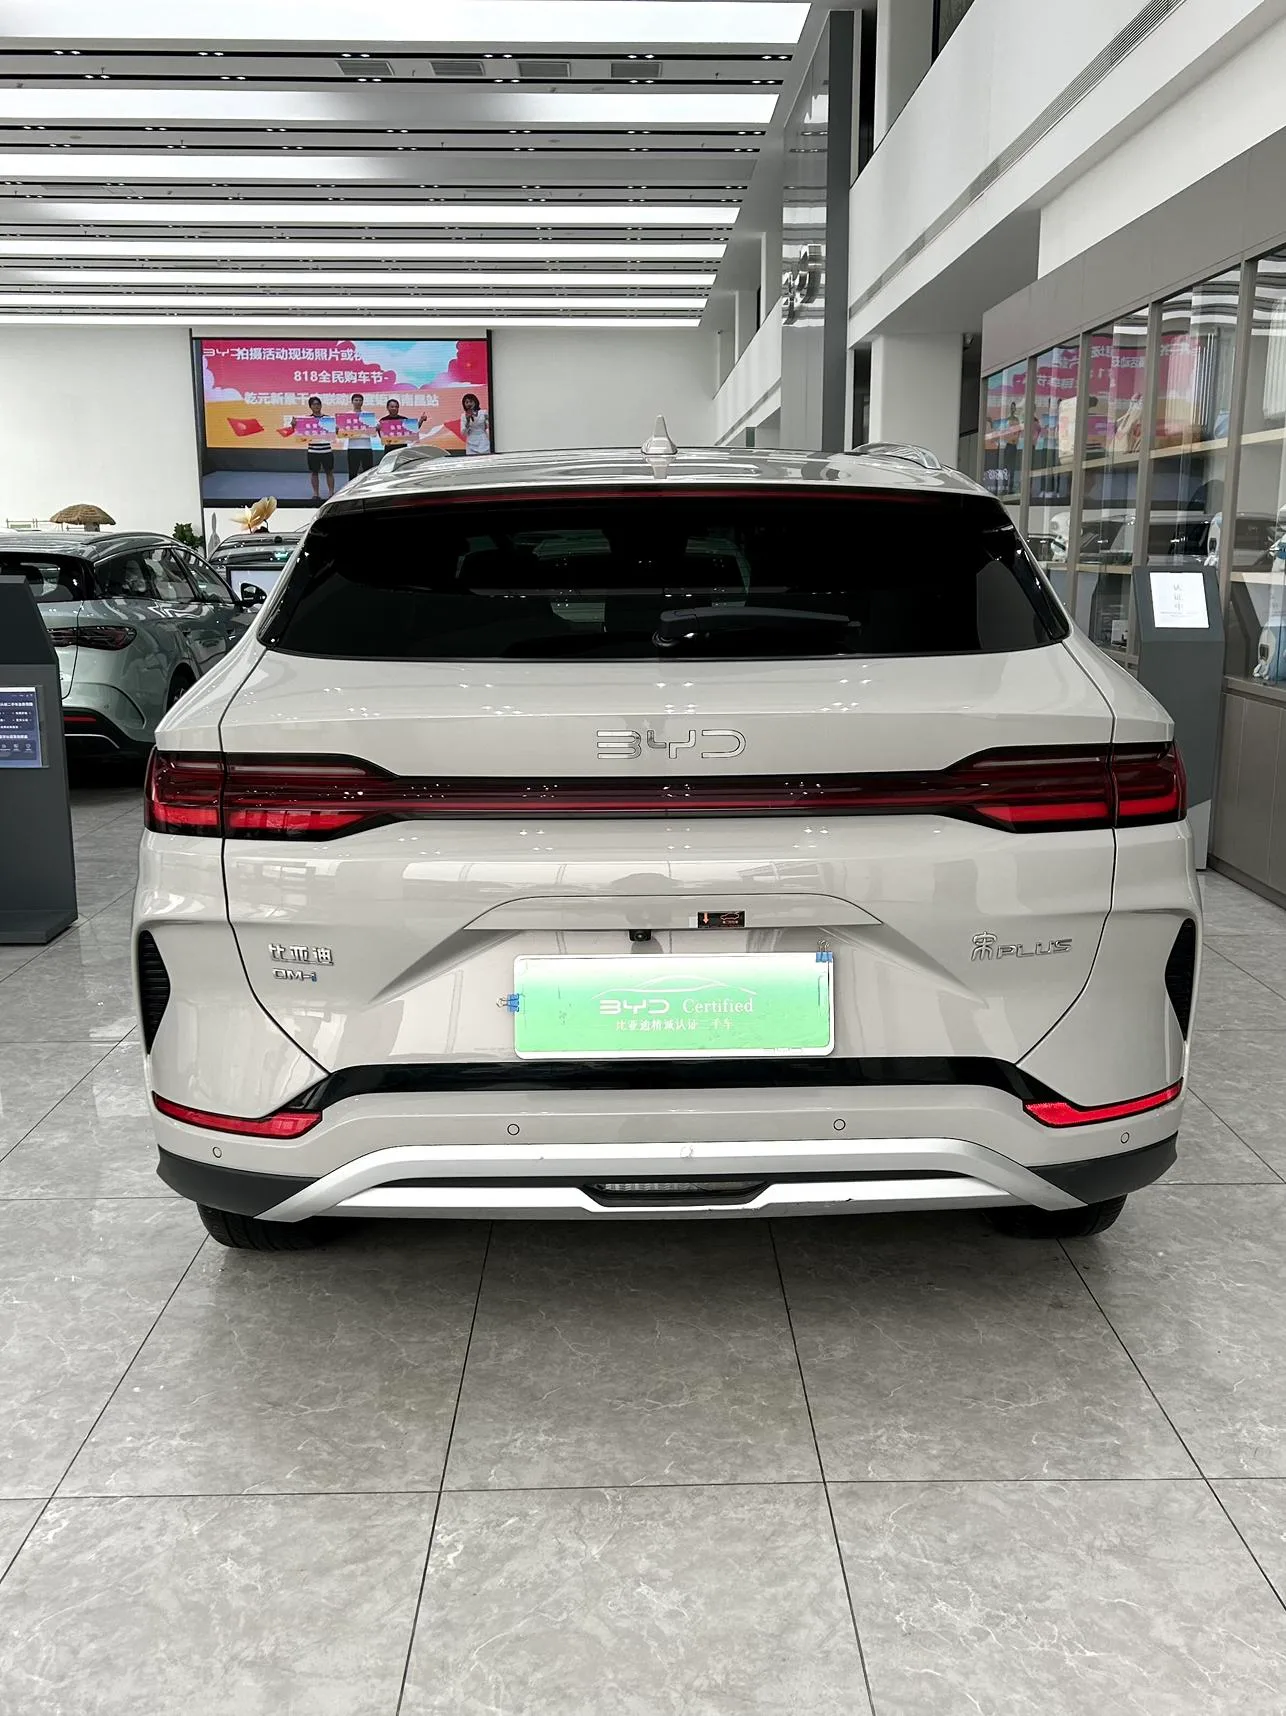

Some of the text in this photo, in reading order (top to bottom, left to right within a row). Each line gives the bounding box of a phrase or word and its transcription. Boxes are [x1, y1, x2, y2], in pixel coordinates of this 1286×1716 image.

[597, 729, 746, 759] BYD
[267, 943, 334, 966] 比亚迪
[599, 998, 753, 1014] BYD Certified
